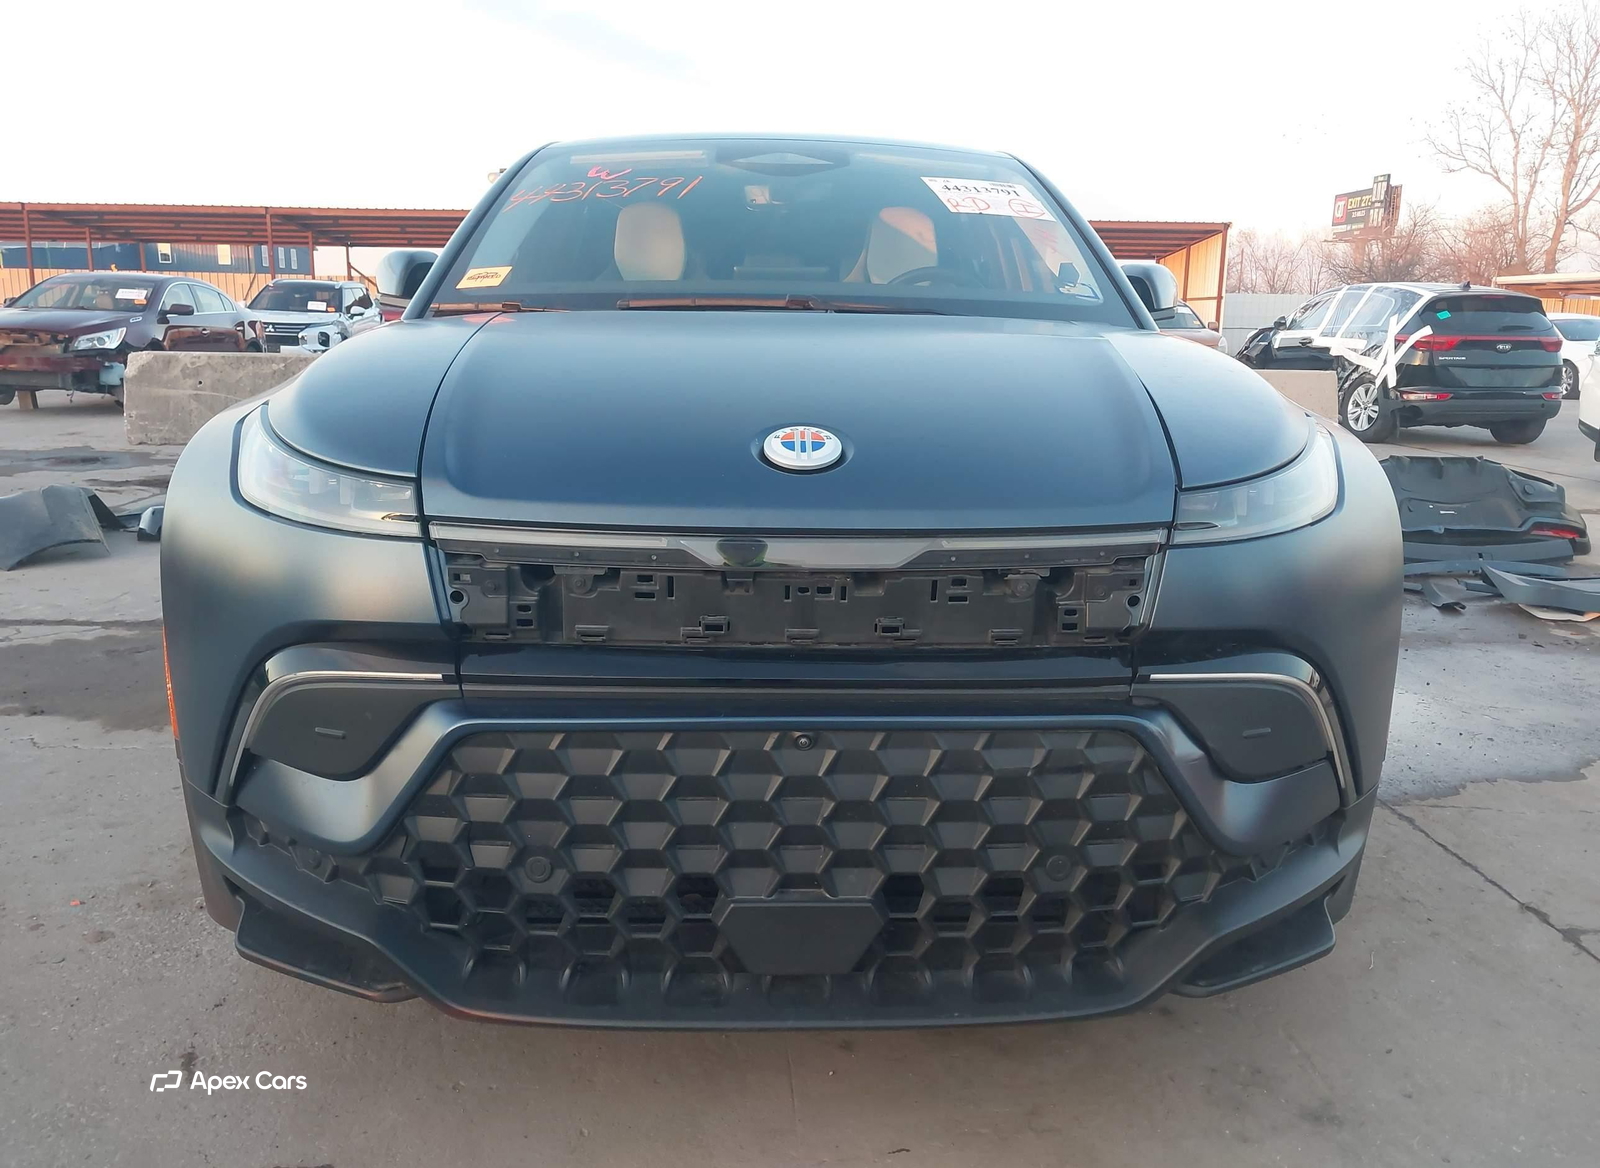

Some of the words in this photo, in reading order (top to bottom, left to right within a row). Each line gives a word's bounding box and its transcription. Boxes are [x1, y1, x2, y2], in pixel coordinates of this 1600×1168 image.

[503, 175, 703, 213] 44313791
[942, 184, 1020, 197] 44313791
[1348, 197, 1361, 209] EXIT
